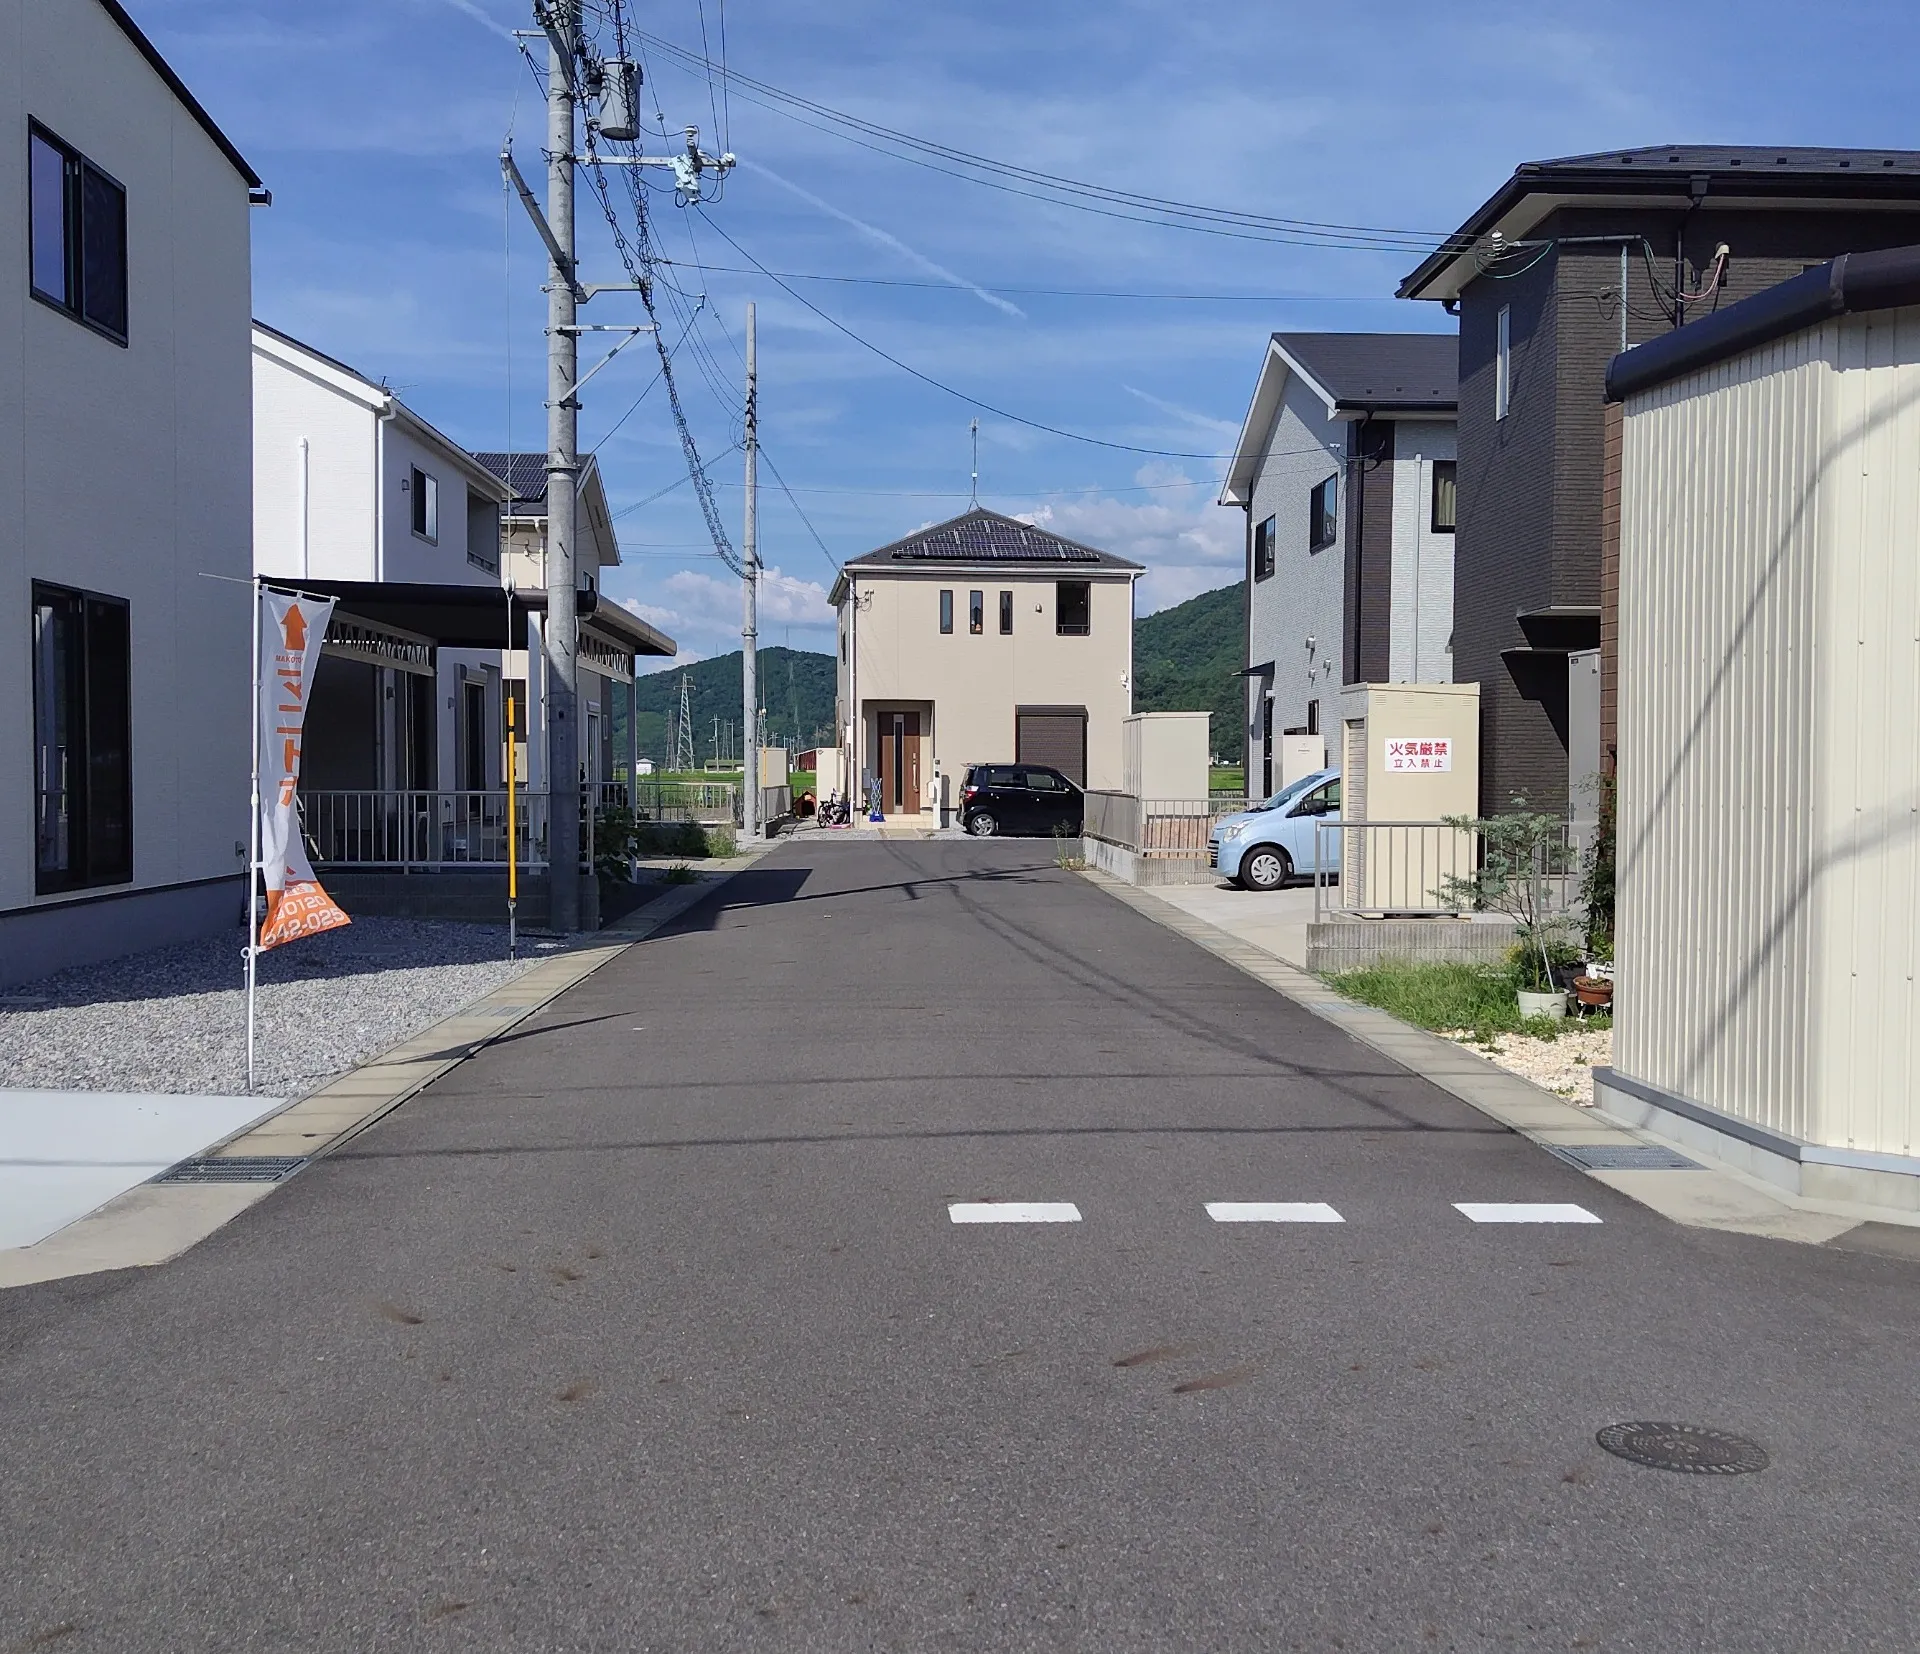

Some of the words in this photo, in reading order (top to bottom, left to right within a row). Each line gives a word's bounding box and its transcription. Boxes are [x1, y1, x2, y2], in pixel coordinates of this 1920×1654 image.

[1389, 742, 1448, 756] 火気厳禁
[1393, 758, 1444, 769] 立入禁止
[284, 895, 327, 916] 0120
